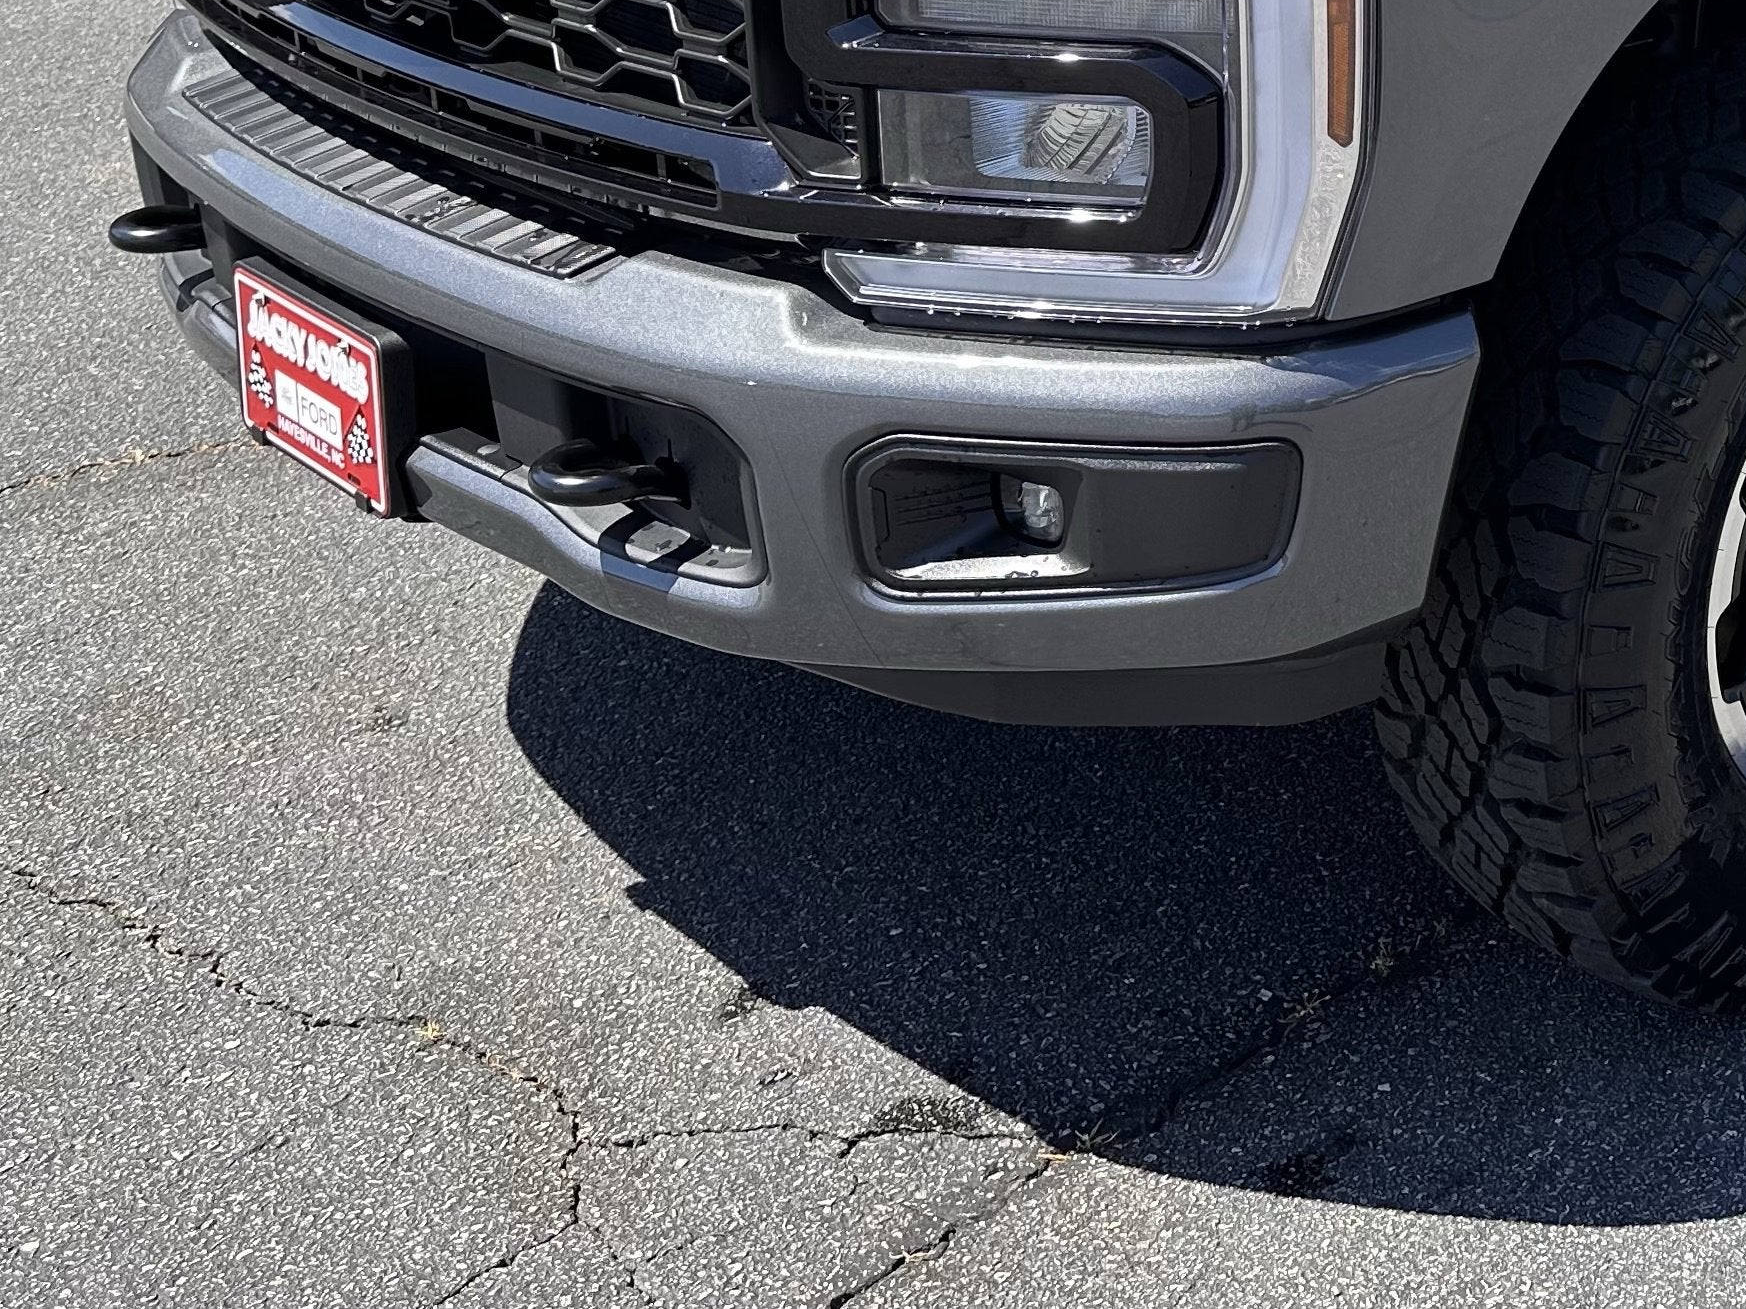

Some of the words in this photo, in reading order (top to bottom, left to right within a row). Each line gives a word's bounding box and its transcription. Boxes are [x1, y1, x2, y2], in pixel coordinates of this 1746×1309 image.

[247, 296, 308, 368] JACKY
[306, 333, 369, 405] JONES
[300, 397, 339, 436] FORD
[330, 447, 346, 469] NC
